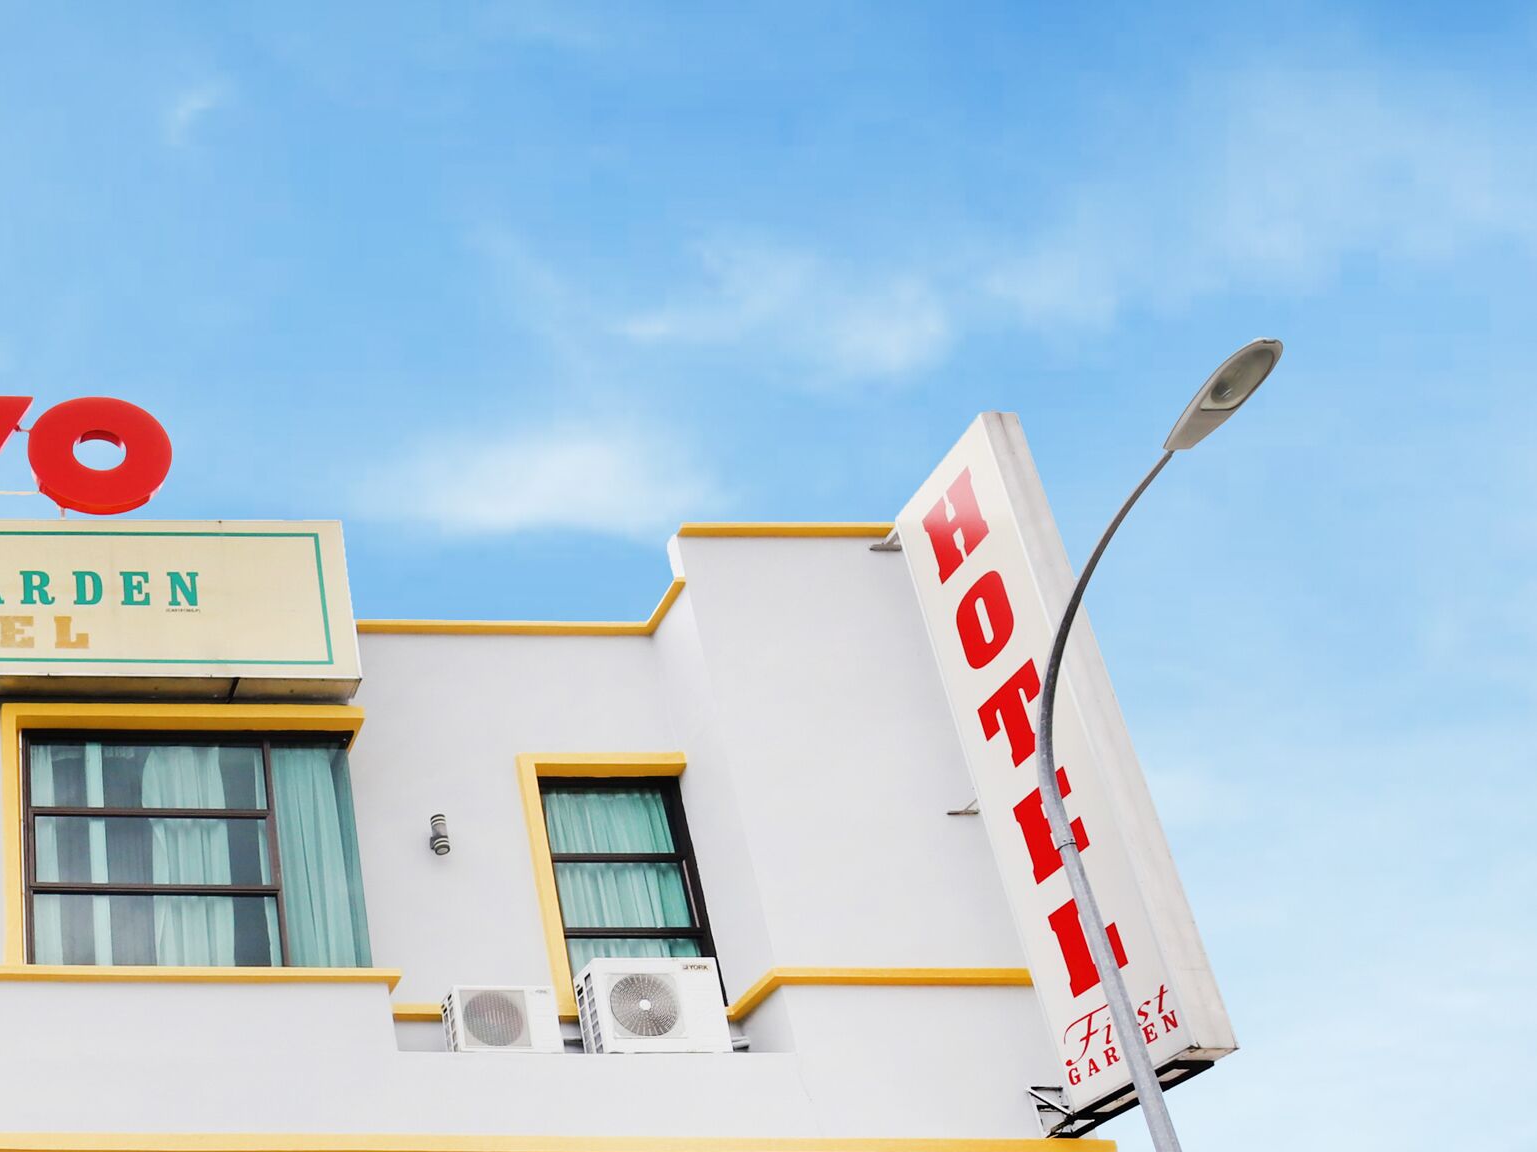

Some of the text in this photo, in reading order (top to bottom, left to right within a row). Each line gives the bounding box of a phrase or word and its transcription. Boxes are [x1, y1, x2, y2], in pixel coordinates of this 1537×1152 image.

[921, 466, 1129, 998] HOTEL
[1063, 984, 1169, 1067] Fist
[1067, 1009, 1179, 1086] GAREN
